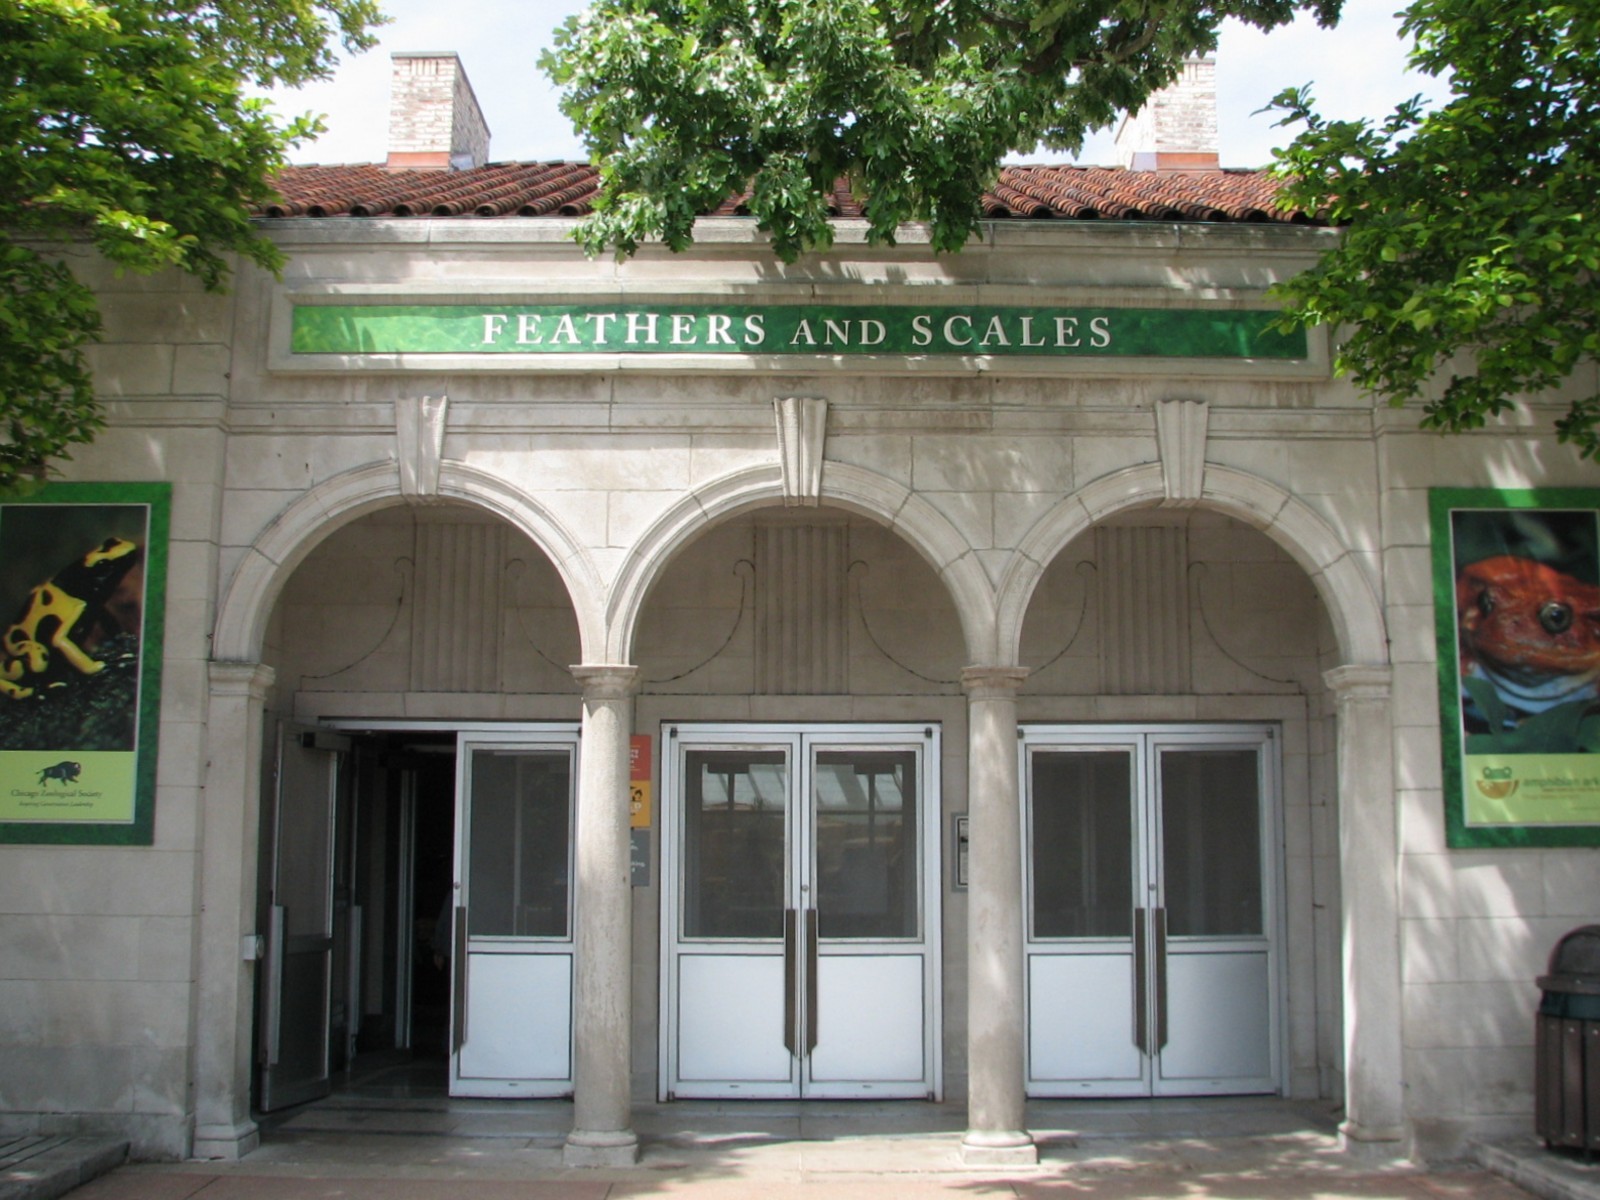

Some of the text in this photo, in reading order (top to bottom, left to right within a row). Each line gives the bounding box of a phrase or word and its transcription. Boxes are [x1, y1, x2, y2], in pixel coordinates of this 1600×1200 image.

[482, 313, 1112, 348] FEATHERS AND SCALES
[11, 789, 102, 798] Chicago Zoological Society
